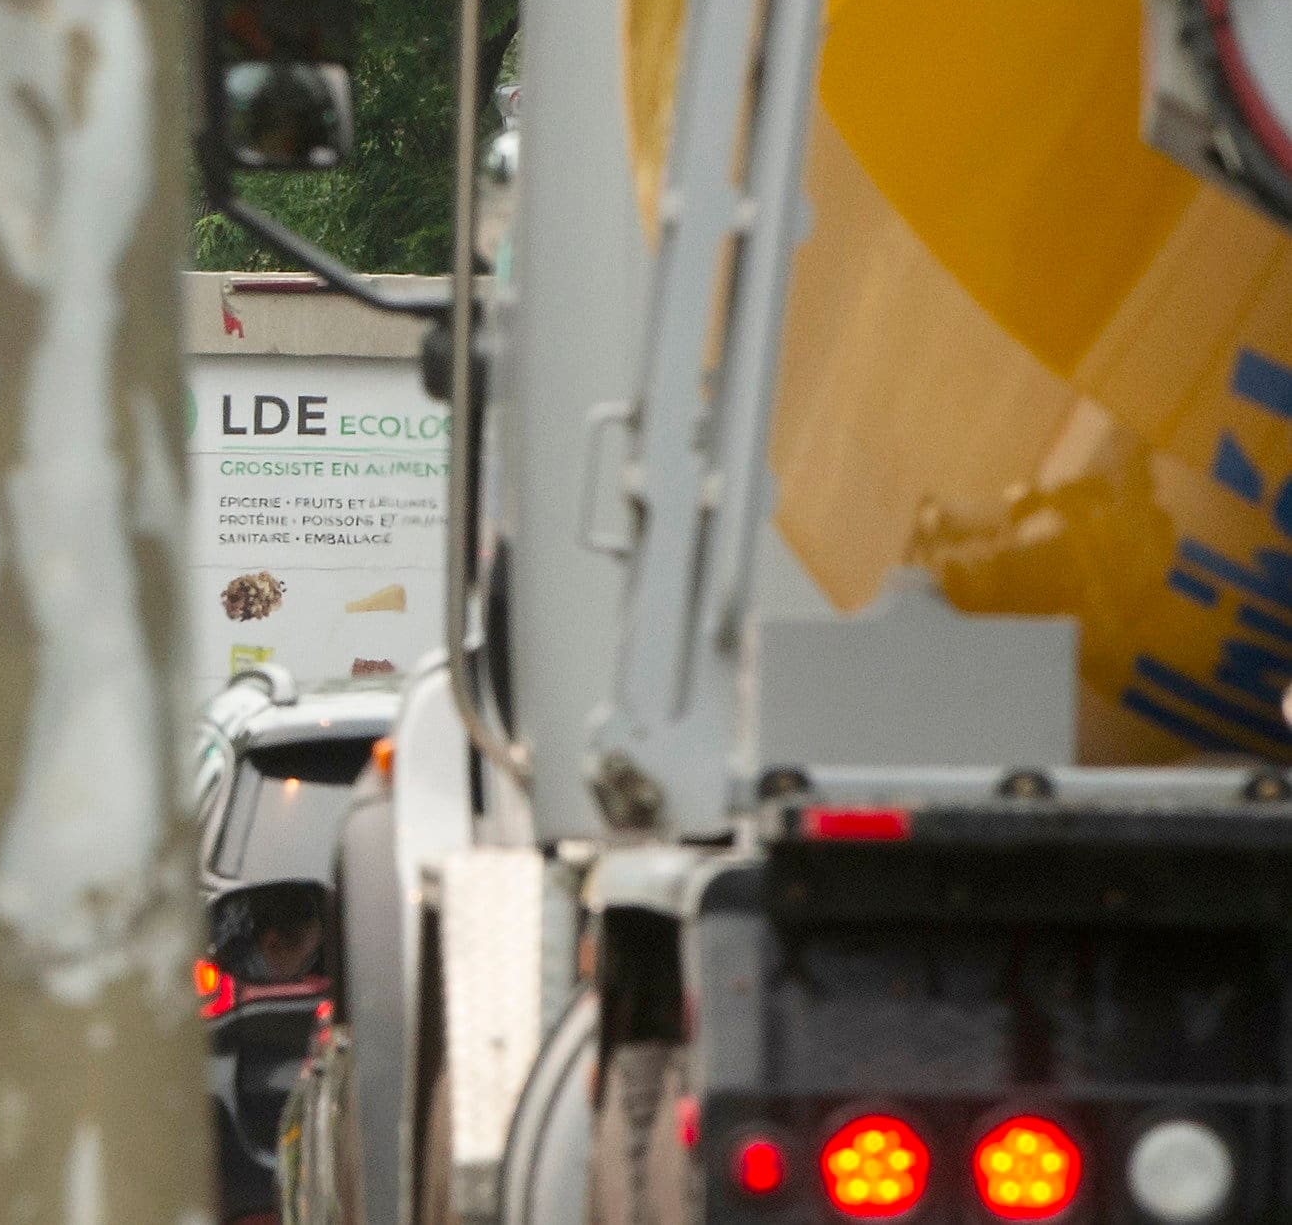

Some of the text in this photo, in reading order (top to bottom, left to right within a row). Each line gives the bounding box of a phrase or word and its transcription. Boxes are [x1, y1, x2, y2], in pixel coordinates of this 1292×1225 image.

[222, 394, 328, 436] LDE
[219, 460, 324, 477] GROSSISTE
[332, 462, 358, 477] EN
[295, 497, 343, 509] FRUITS
[348, 498, 365, 510] ET
[219, 532, 290, 545] SANITAIRE
